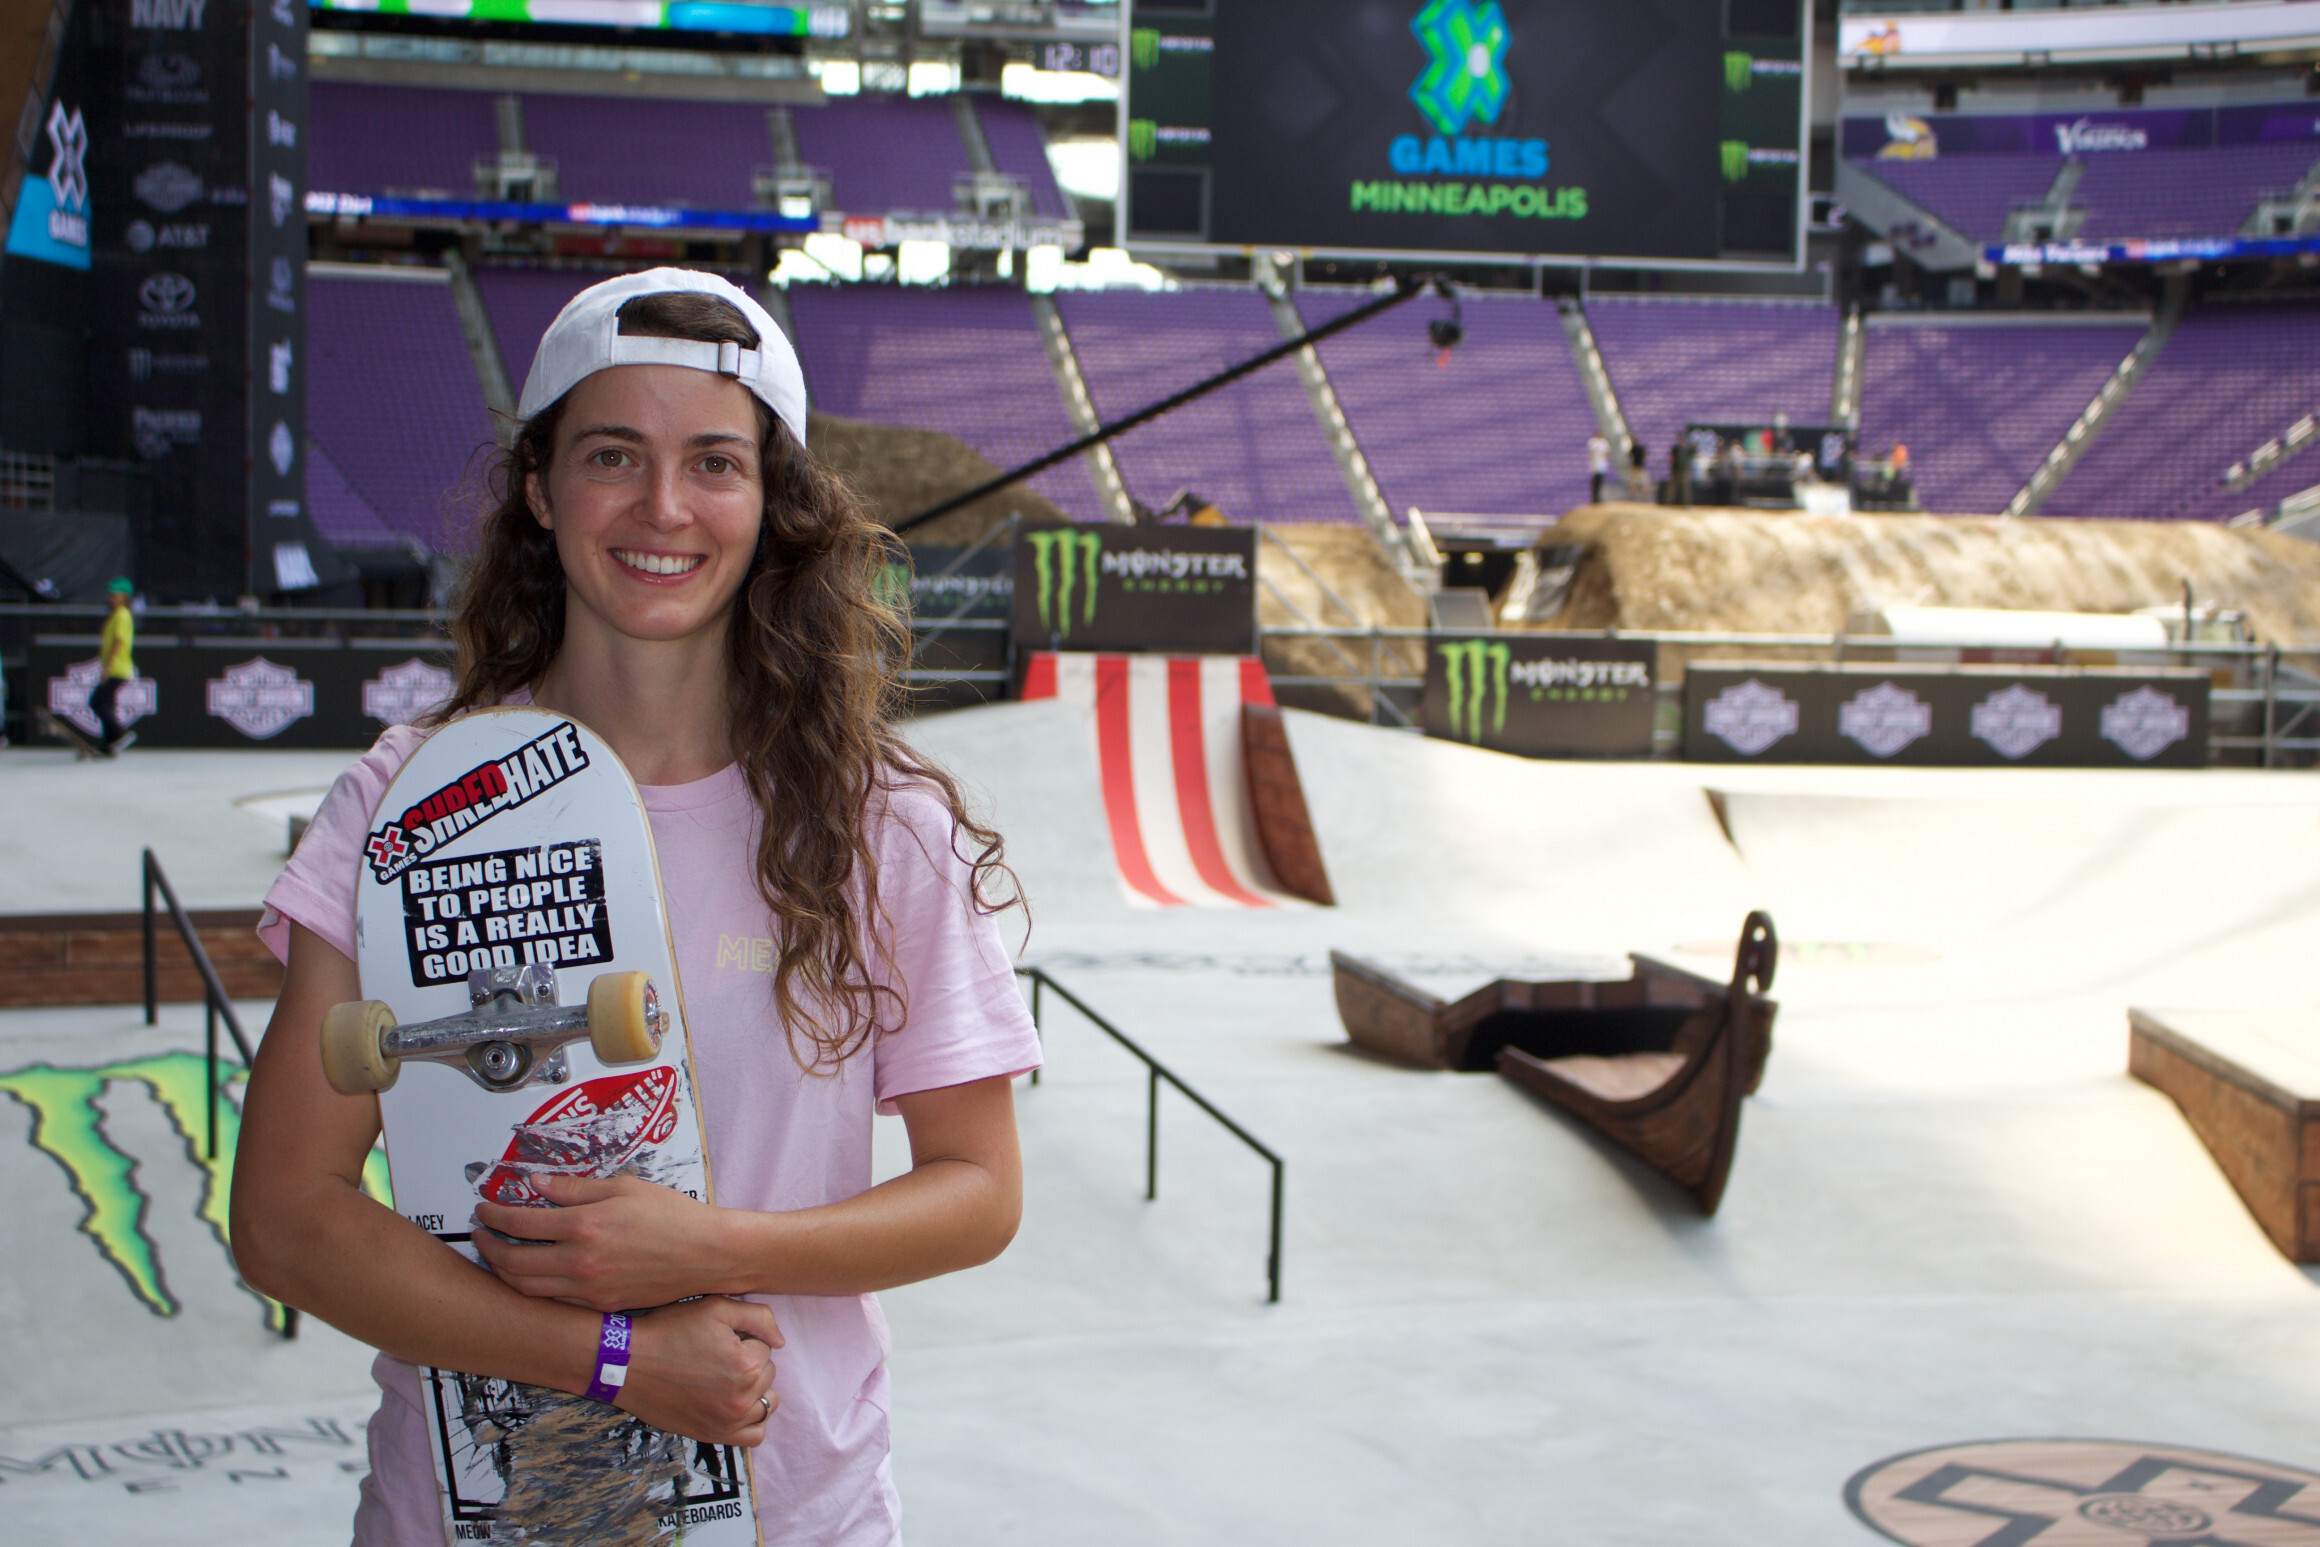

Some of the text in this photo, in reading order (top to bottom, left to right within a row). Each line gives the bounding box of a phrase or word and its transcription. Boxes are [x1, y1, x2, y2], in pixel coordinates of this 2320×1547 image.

[130, 0, 204, 30] NAVY
[1045, 43, 1118, 77] 12:10
[1389, 134, 1550, 179] GAMES
[1351, 179, 1589, 220] MINNEAPOLIS
[158, 226, 210, 248] AT&T
[1102, 547, 1248, 580] MONSTER
[1510, 656, 1649, 688] MONSTER
[379, 851, 418, 881] GAMES
[408, 847, 593, 894] BEING NICE
[417, 876, 588, 921] TO PEOPLE
[415, 903, 597, 952] IS A REALLY
[422, 933, 601, 979] GOOD IDEA
[408, 1214, 444, 1231] ACEY
[455, 1523, 491, 1540] MEOW
